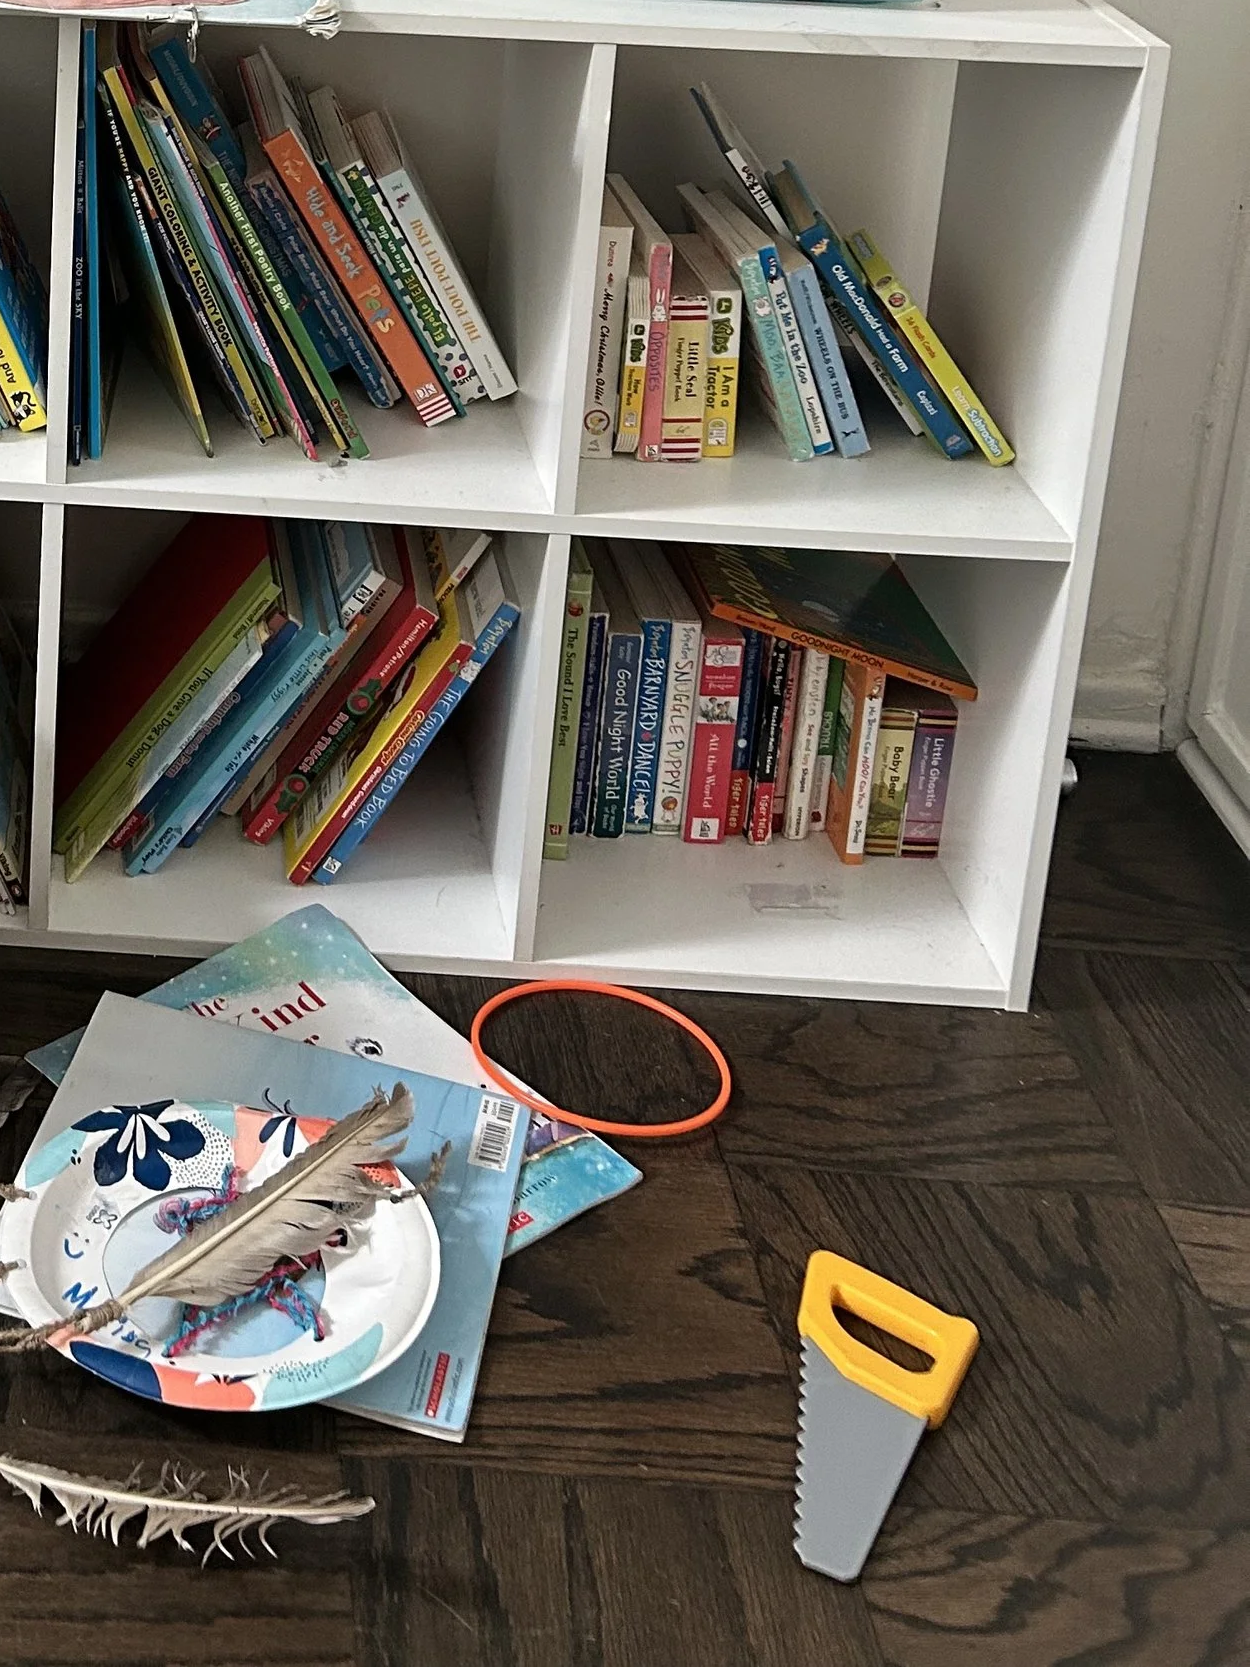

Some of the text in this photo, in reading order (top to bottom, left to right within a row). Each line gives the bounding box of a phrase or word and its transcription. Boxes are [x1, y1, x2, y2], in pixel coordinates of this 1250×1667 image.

[147, 167, 168, 202] GIANT
[163, 202, 193, 257] COLORING
[192, 267, 220, 316] ACTIVITY
[214, 318, 233, 348] BOOK
[219, 182, 245, 223] Another
[241, 222, 258, 248] First
[254, 248, 276, 283] Poetry
[272, 283, 291, 312] Book
[305, 185, 325, 219] Hide
[322, 217, 343, 245] and
[334, 243, 365, 280] Seek
[357, 284, 395, 334] Pets
[409, 218, 468, 320] POUT-POUT FISH
[607, 240, 618, 266] Dunrea
[421, 302, 442, 327] pollo
[599, 287, 614, 322] Merry
[831, 264, 909, 374] Old MacDonald Farm
[649, 330, 665, 393] OPPOSITES
[711, 317, 735, 355] KIDS
[776, 291, 808, 385] Put the Zoo
[911, 325, 937, 359] Flash Cards
[0, 363, 17, 385] And
[685, 342, 700, 398] Little Seal
[705, 365, 720, 409] Tractor
[721, 372, 734, 396] Am
[813, 326, 849, 421] WHEELS THE BUS
[952, 385, 1002, 458] Learn Subtraction
[790, 631, 886, 669] GOODNIGHT MOON
[906, 670, 932, 684] Harper
[558, 627, 578, 747] The Sound Love Best
[615, 667, 632, 708] Good
[125, 675, 207, 769] You Give Dog Donut
[298, 712, 350, 773] RED TRUCK
[607, 709, 628, 754] Night
[632, 657, 666, 792] BARNYARD DANCE!
[661, 660, 695, 795] SNUGGLE PUPPY!
[353, 687, 462, 829] THE GOING TO BED BOOK
[604, 754, 624, 800] World
[701, 733, 721, 809] All the World
[799, 768, 809, 793] Shapes
[887, 746, 905, 801] Baby Bear
[926, 737, 945, 808] Little Ghostie
[255, 818, 275, 837] Viking
[728, 803, 740, 829] tales
[756, 794, 770, 839] tiger tales
[855, 820, 863, 829] Dr.
